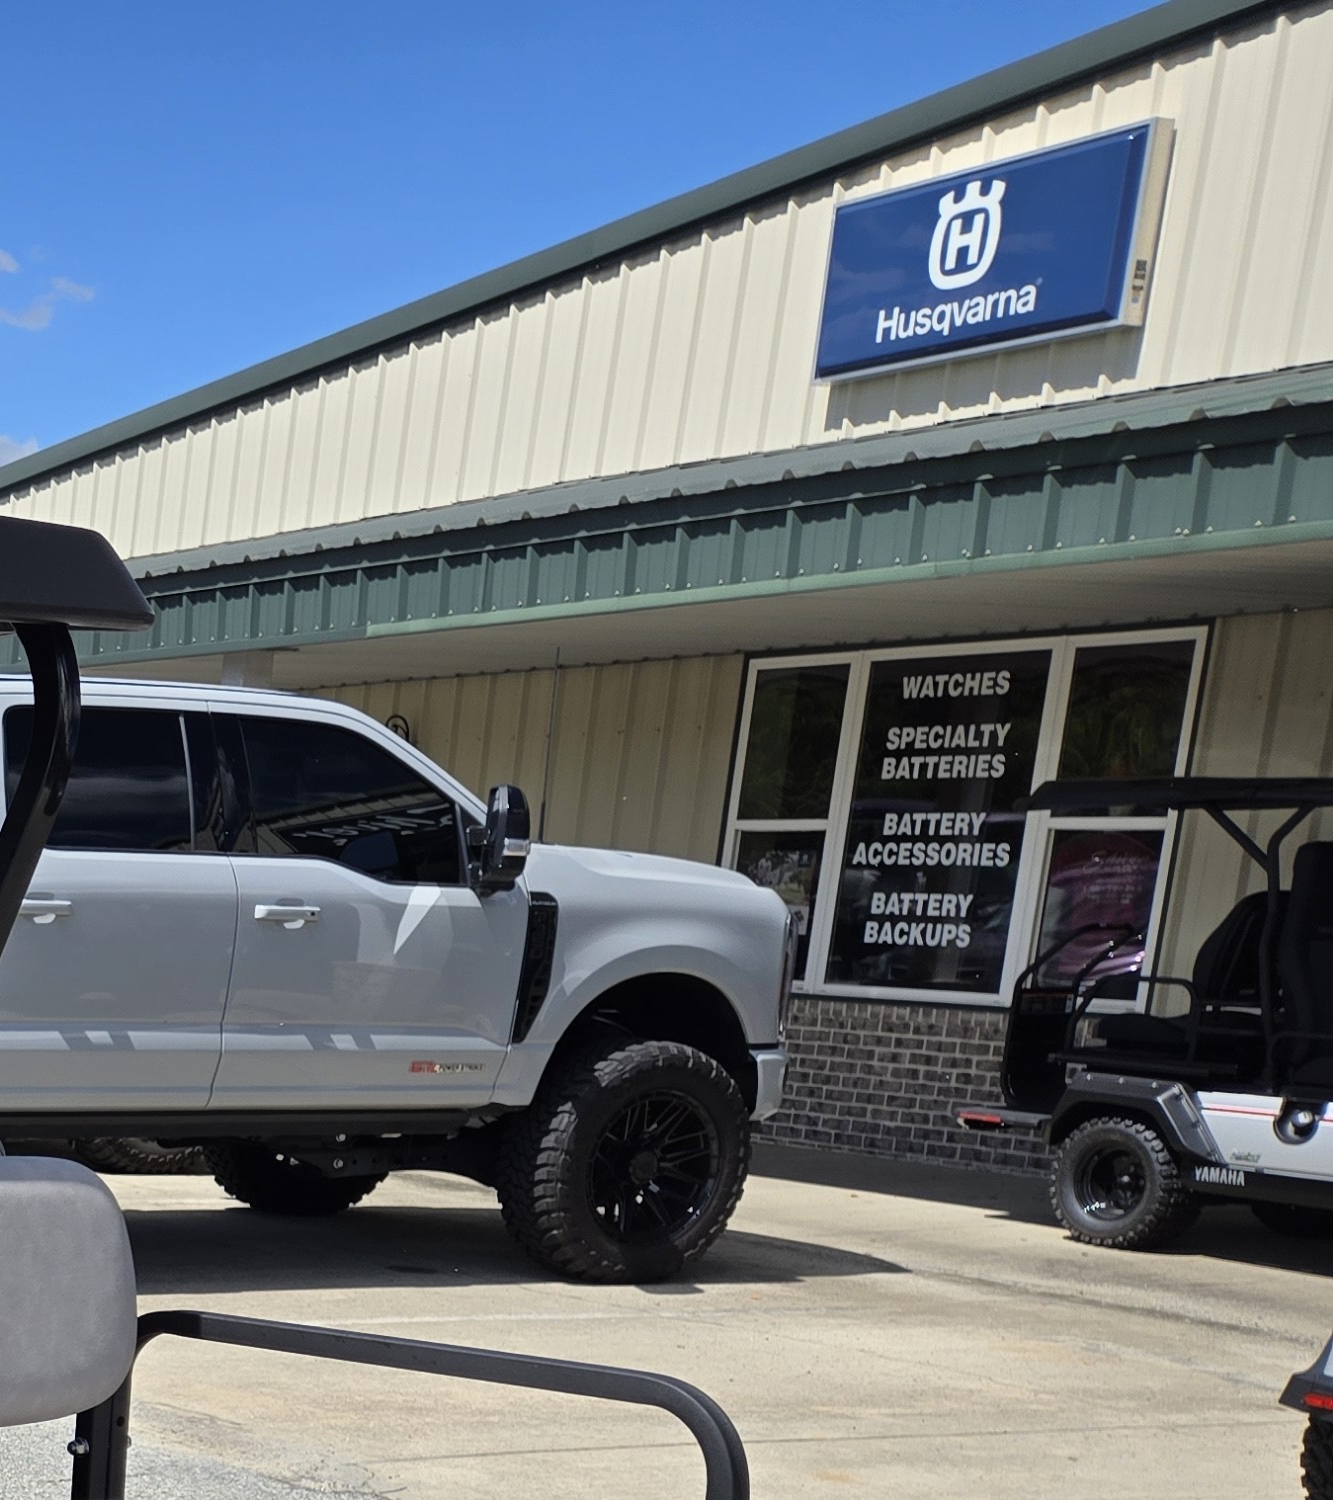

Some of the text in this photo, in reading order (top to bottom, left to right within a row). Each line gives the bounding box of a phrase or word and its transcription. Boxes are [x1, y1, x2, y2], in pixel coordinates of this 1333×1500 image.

[875, 284, 1037, 344] Husqvarna
[902, 670, 1011, 700] WATCHES
[885, 723, 1012, 750] SPECIALTY
[881, 754, 1006, 780] BATTERIES
[883, 812, 986, 836] BATTERY
[852, 842, 1011, 868] ACCESSORIES
[870, 892, 973, 918] BATTERY
[863, 921, 971, 948] BACKUPS
[1195, 1165, 1246, 1187] YAMAHA
